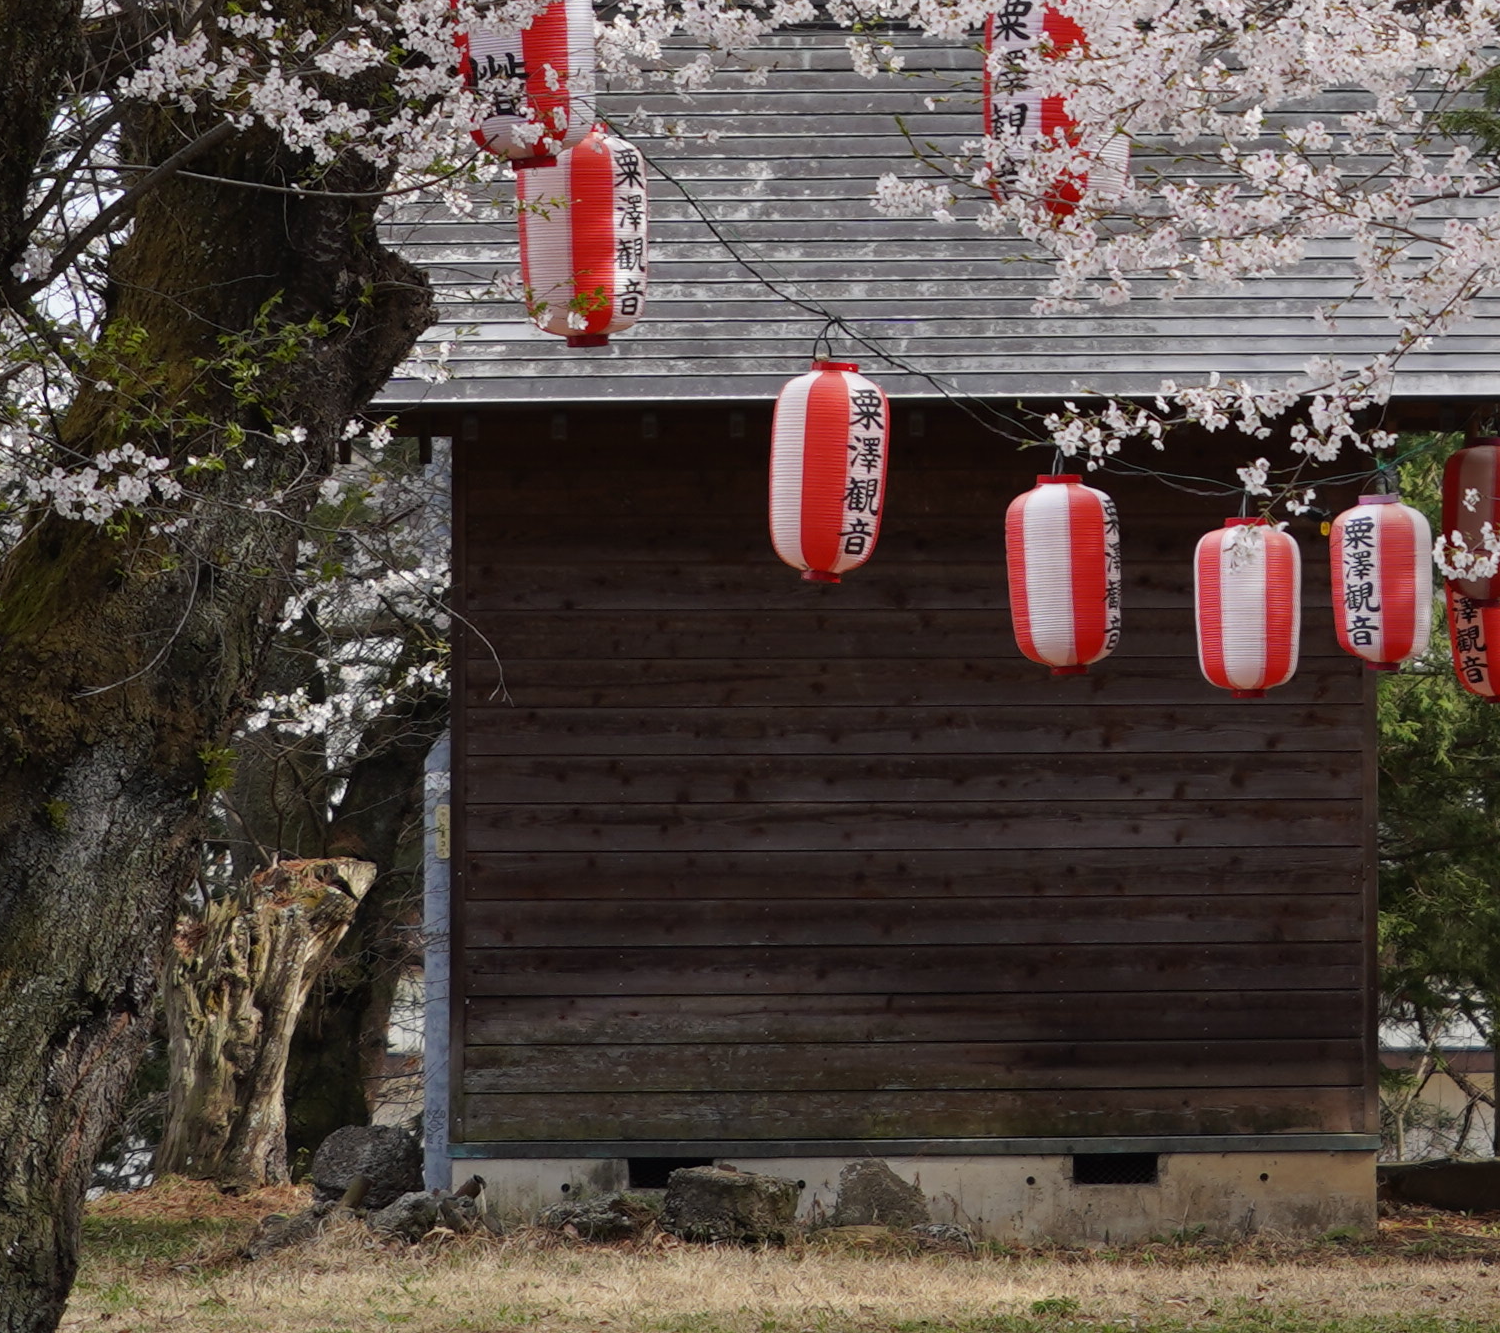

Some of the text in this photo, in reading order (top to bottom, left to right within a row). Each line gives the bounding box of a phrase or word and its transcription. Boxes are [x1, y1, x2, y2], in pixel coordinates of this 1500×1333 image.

[614, 148, 646, 316] 粟澤観音
[837, 388, 885, 555] 粟澤観音
[1343, 515, 1381, 647] 粟澤観音
[1452, 595, 1489, 684] 澤観音
